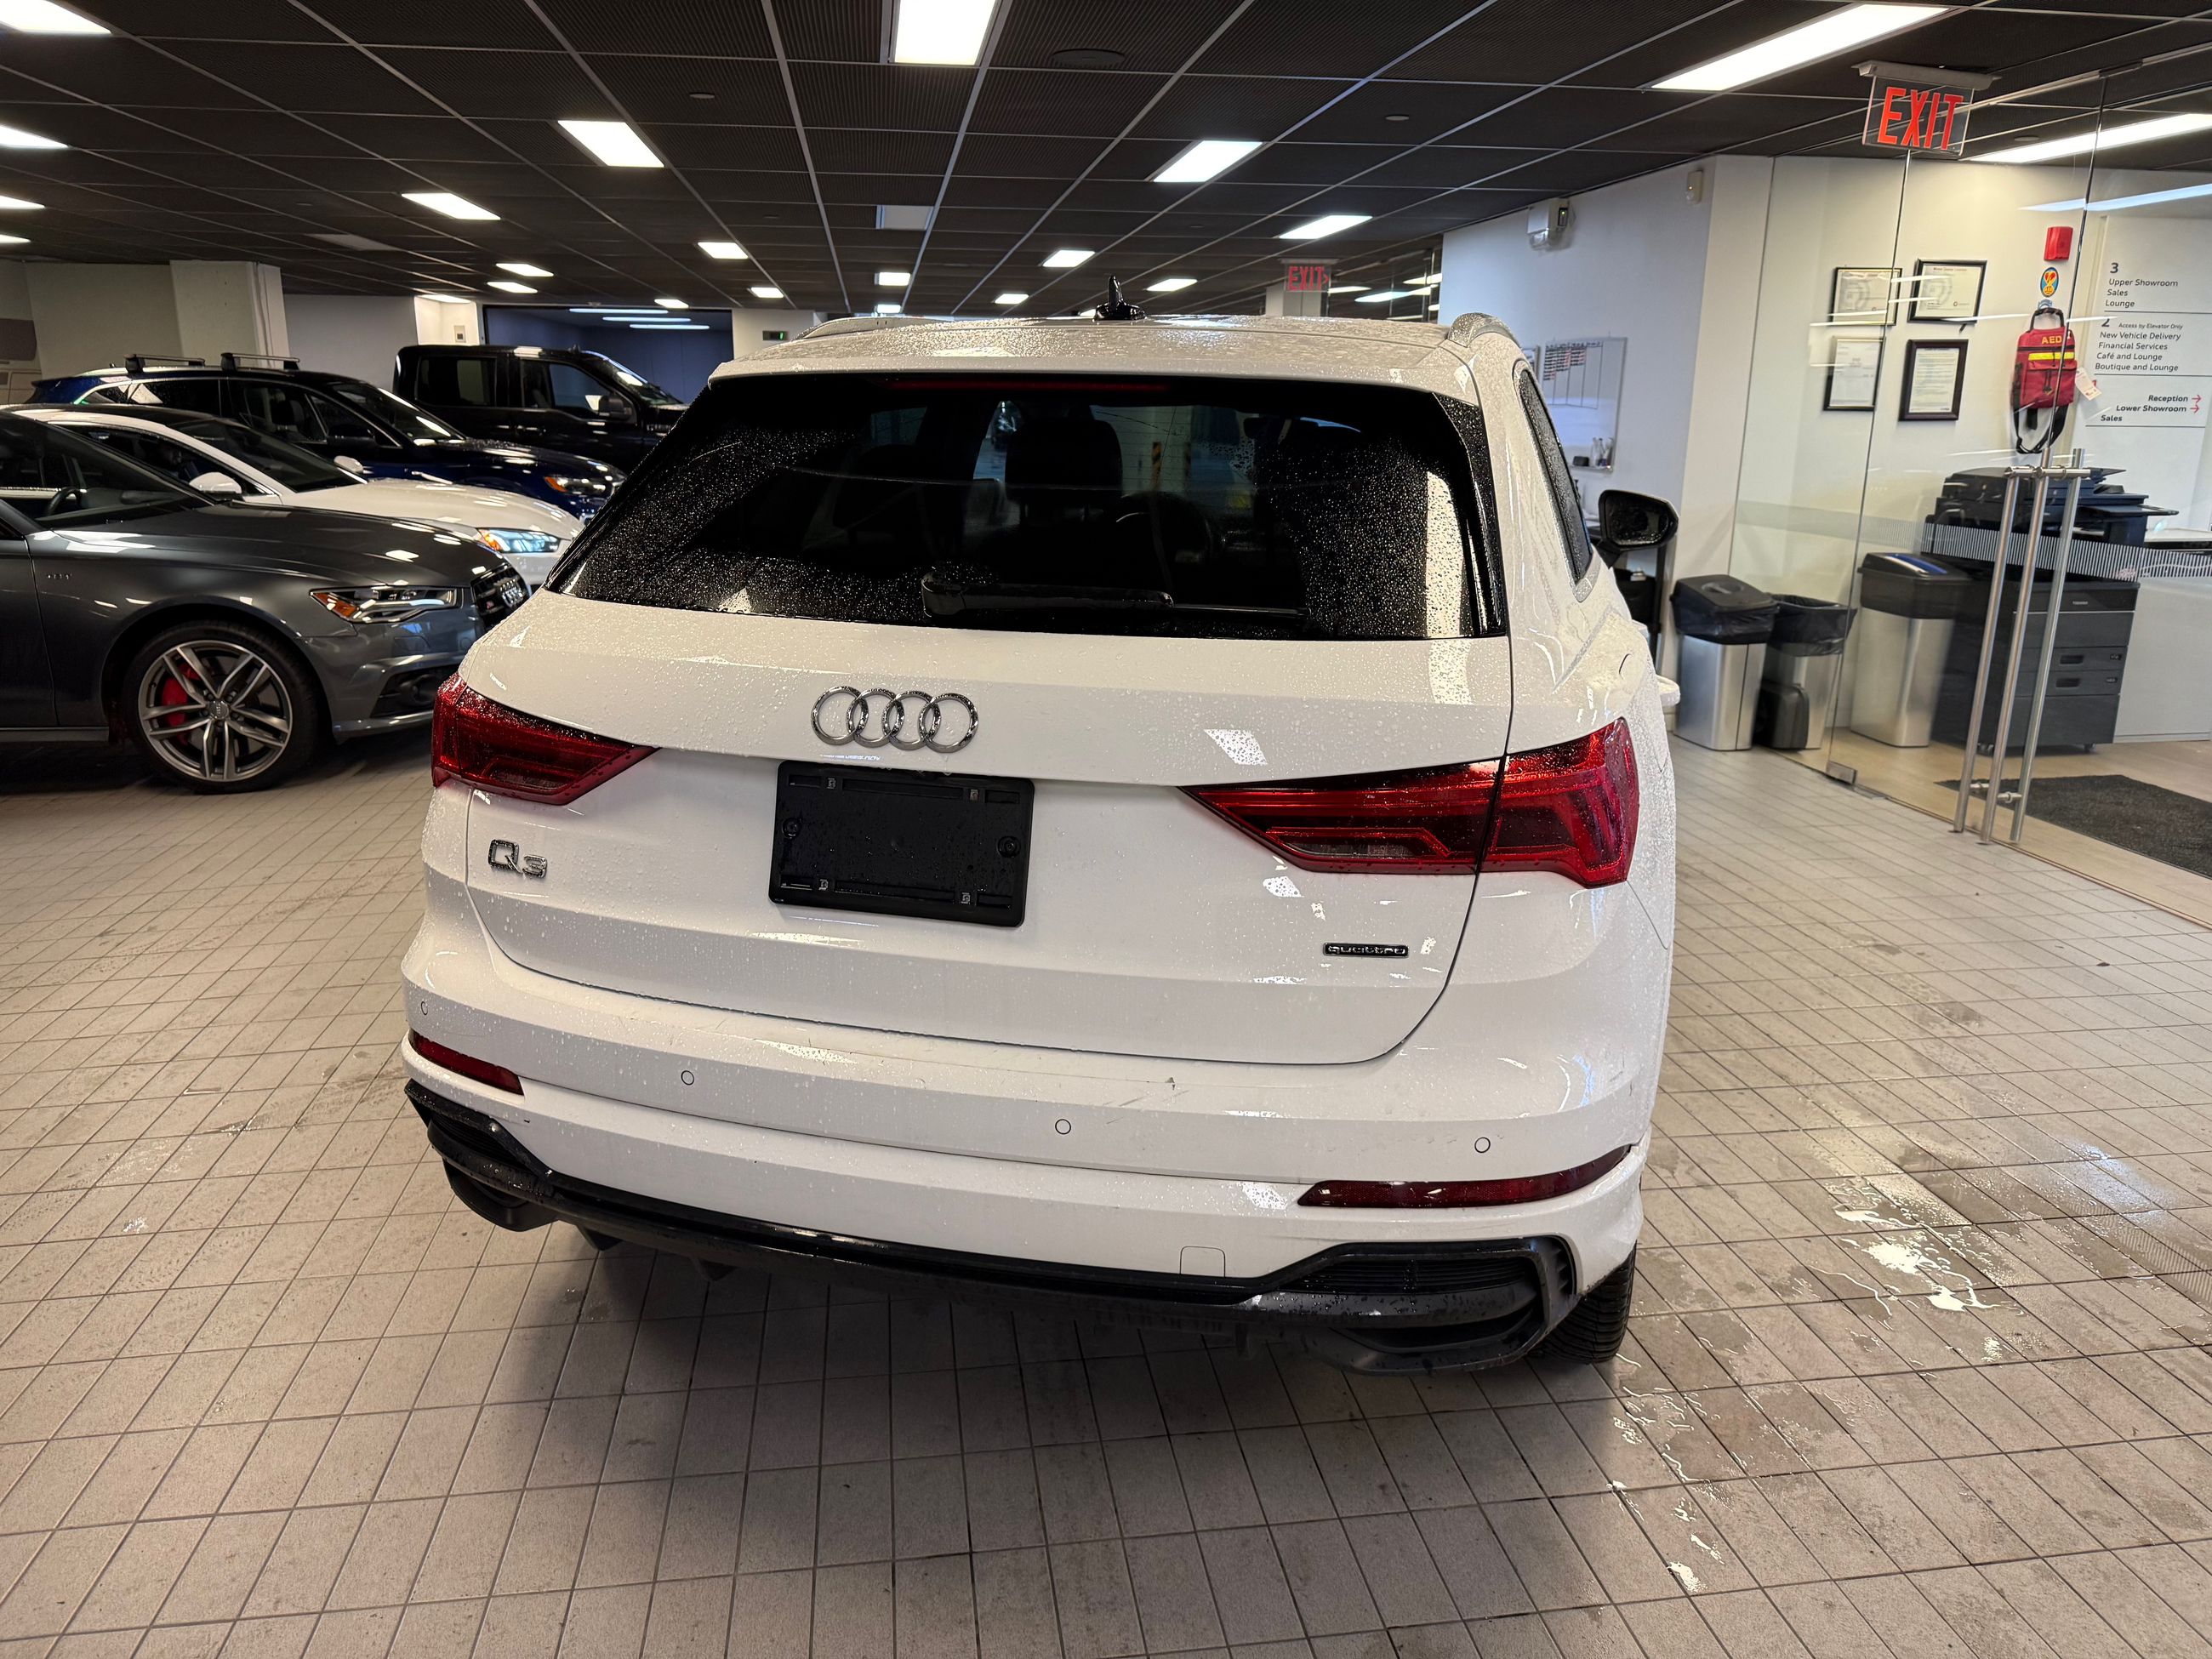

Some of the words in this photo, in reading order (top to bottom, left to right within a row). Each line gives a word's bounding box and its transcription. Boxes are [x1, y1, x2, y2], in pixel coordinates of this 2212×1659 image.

[1878, 87, 1964, 151] EXIT
[2110, 262, 2118, 274] 3
[1288, 265, 1325, 292] EXIT
[2109, 278, 2133, 288] Upper
[2106, 299, 2135, 309] Lounge
[2042, 336, 2062, 345] AED
[2149, 332, 2181, 341] Delivery
[2136, 342, 2168, 351] Services
[2095, 362, 2130, 372] Boutique
[2150, 364, 2179, 373] Lounge
[2148, 395, 2189, 403] Reception
[488, 839, 547, 878] Q3
[1326, 944, 1406, 955] quattro
